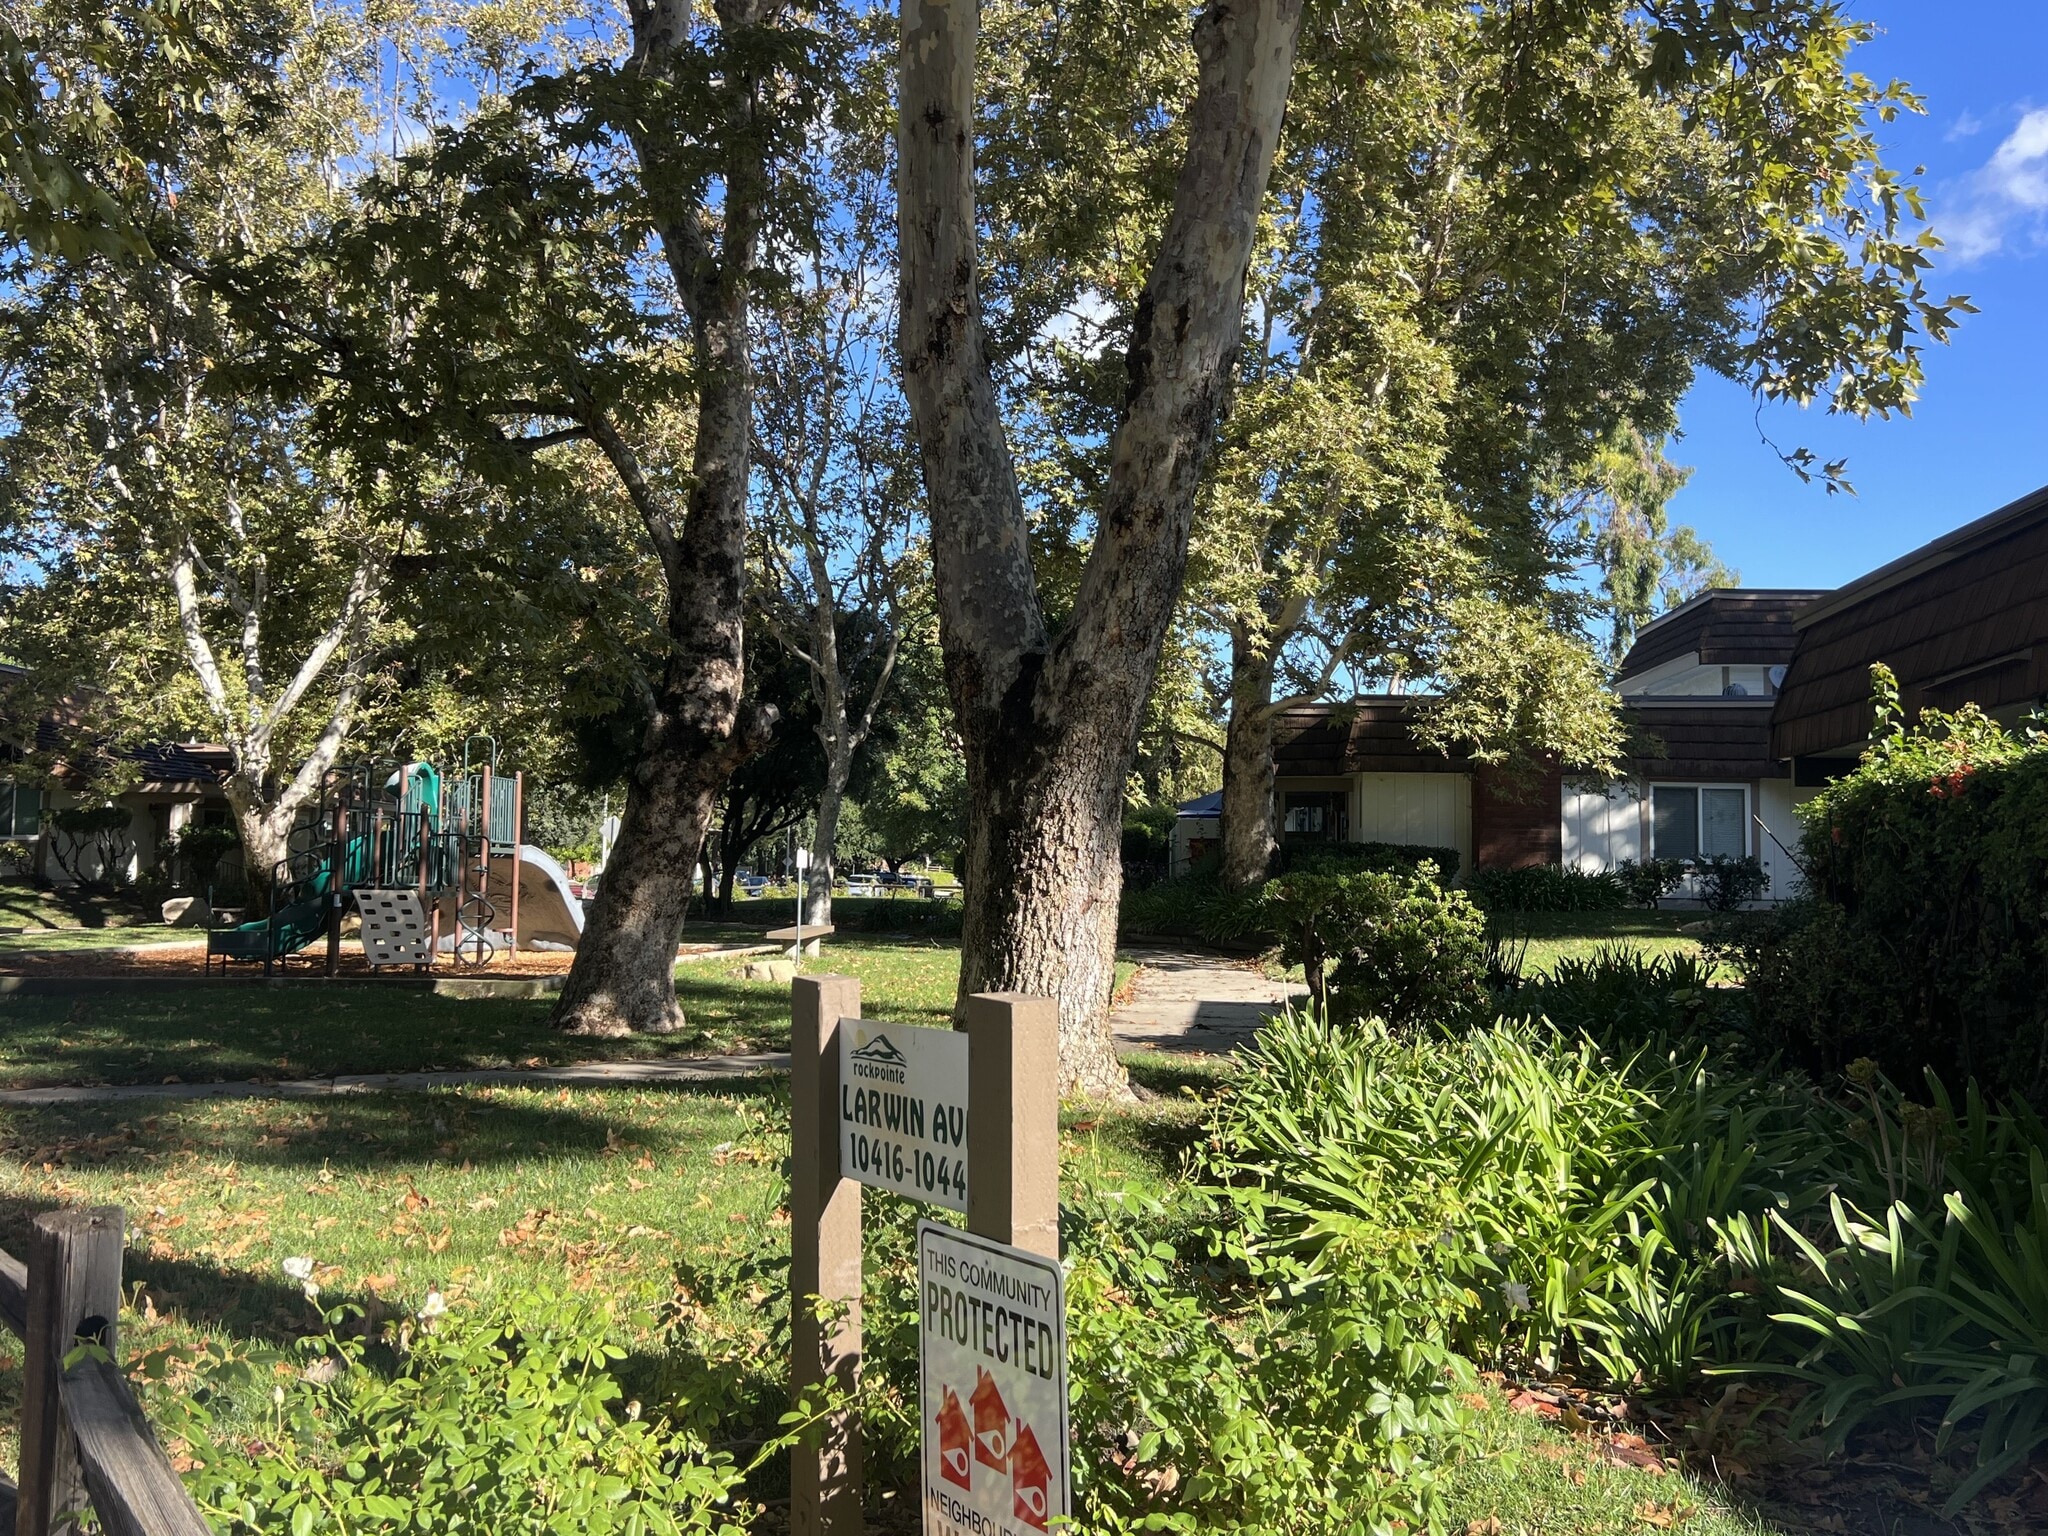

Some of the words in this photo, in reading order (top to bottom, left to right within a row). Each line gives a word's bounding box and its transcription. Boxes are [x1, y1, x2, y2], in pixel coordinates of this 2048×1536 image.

[853, 1062, 905, 1085] rockpointe
[842, 1084, 924, 1138] LARWIN
[933, 1102, 968, 1147] AV
[850, 1132, 966, 1201] 10416-1044
[927, 1249, 956, 1278] THIS
[960, 1261, 1051, 1312] COMMUNITY
[928, 1280, 1053, 1380] PROTECTED
